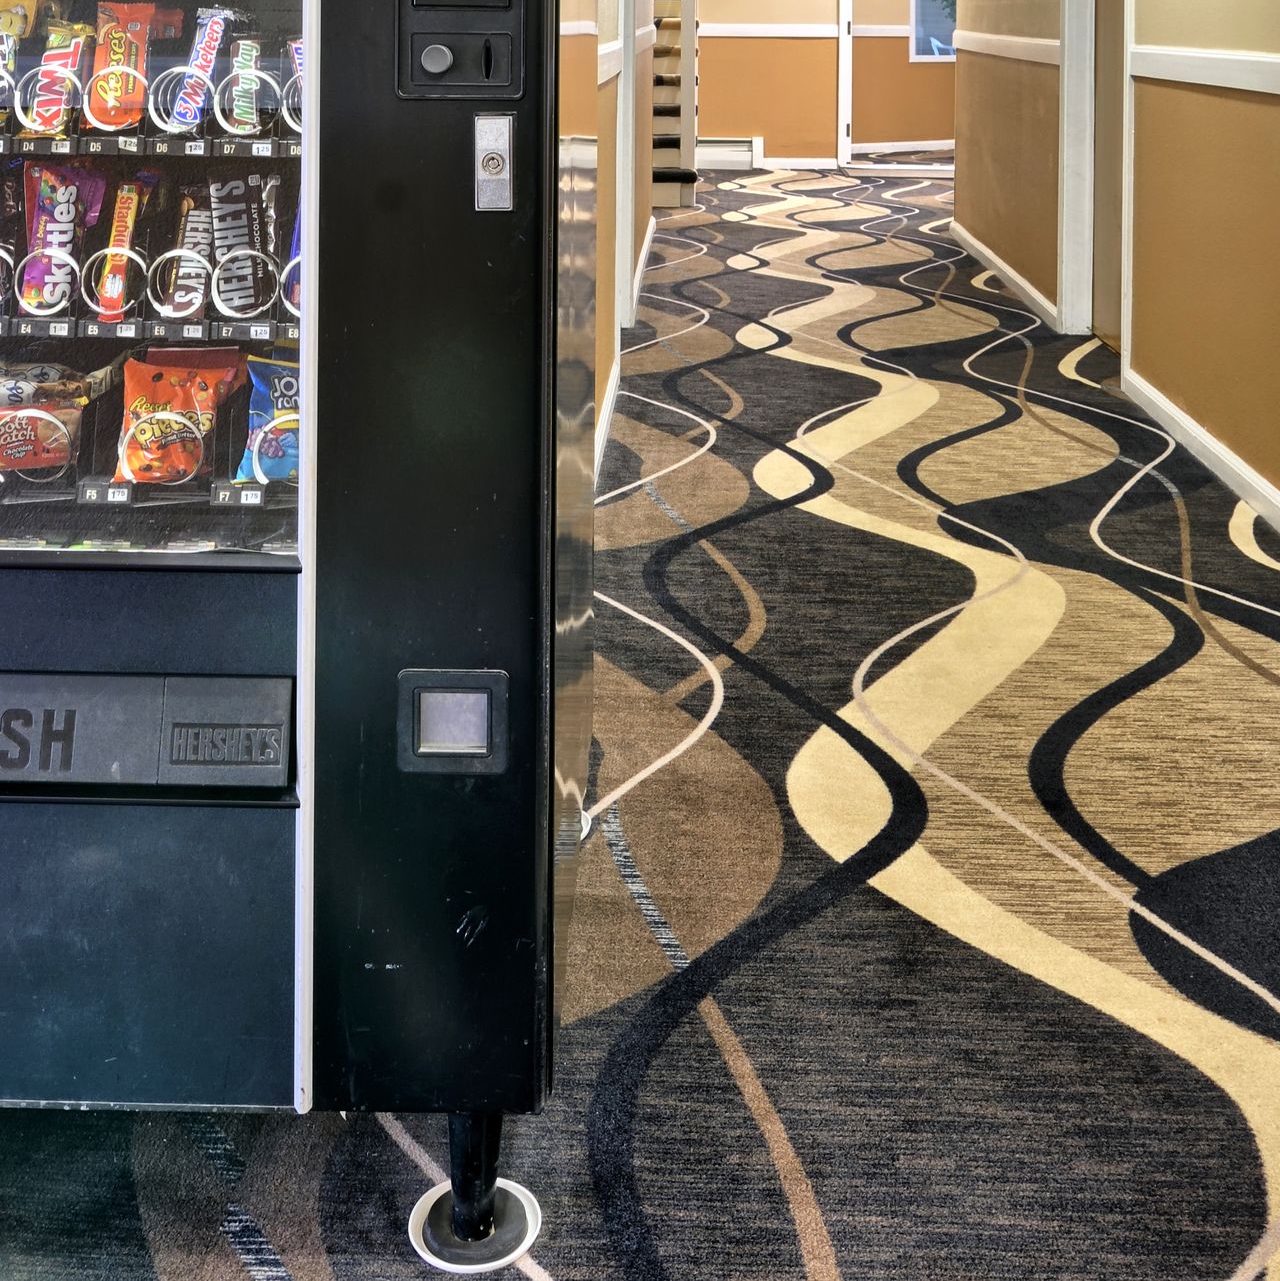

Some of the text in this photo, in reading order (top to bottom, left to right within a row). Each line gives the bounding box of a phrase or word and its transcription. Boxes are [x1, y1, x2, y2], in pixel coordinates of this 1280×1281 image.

[178, 18, 224, 120] 3 Muketeers
[34, 36, 83, 127] TWIX
[233, 41, 261, 122] Milky Way
[23, 142, 34, 151] D4
[90, 142, 101, 152] D5
[157, 144, 168, 153] D6
[223, 145, 236, 154] D7
[291, 146, 302, 154] D8
[112, 195, 134, 265] Starbust
[251, 203, 260, 254] CHOCOLATE
[210, 180, 256, 308] HERSHEY'S
[174, 210, 212, 304] HERSHEY'S
[21, 324, 32, 333] E4
[88, 325, 99, 334] E5
[154, 326, 165, 335] E6
[222, 328, 232, 337] E7
[288, 329, 298, 337] E8
[272, 376, 299, 397] JO
[277, 396, 299, 409] ran
[133, 411, 215, 449] Pieces
[2, 444, 34, 457] Chocolate
[10, 451, 26, 460] Chip
[86, 489, 97, 499] F5
[219, 491, 230, 501] F7
[171, 725, 281, 764] HERSHEY'S
